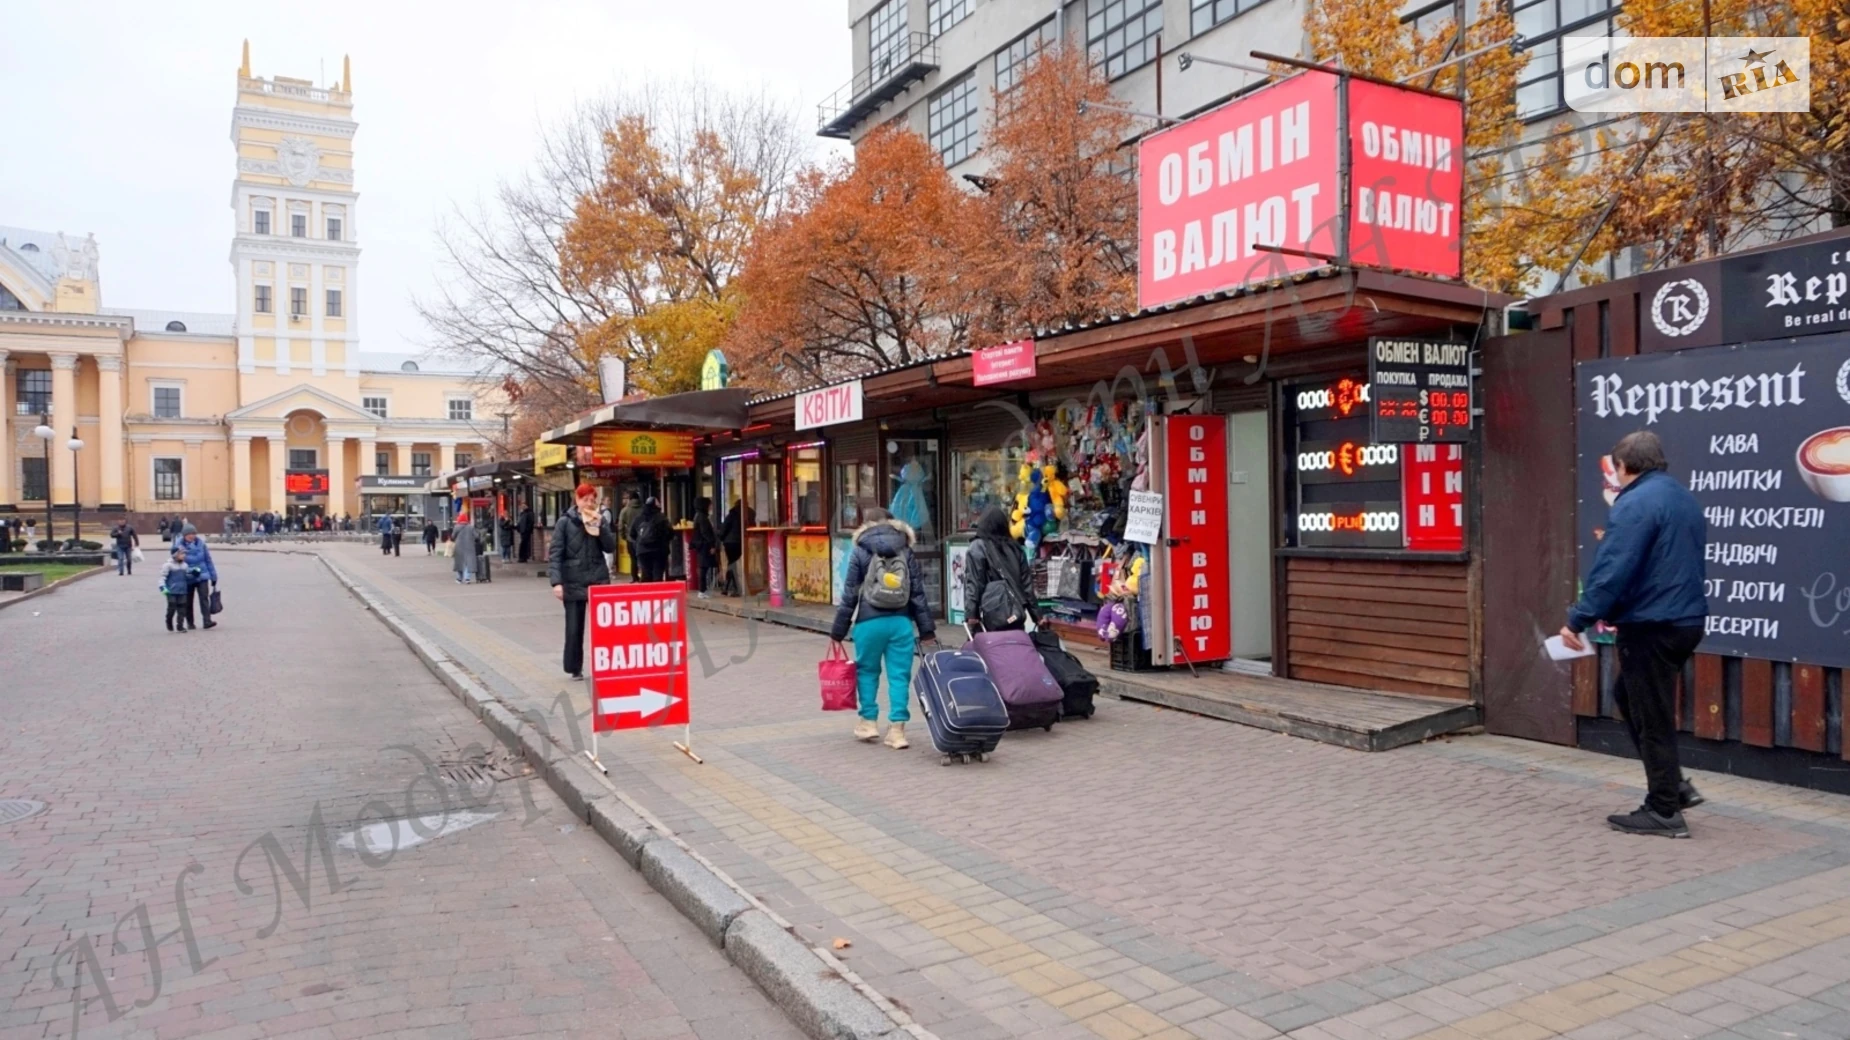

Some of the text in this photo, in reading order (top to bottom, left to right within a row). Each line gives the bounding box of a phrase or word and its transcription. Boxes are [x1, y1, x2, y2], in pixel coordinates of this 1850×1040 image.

[1158, 101, 1310, 206] ОБМІН
[1361, 121, 1451, 172] ОБМІН
[1358, 186, 1453, 238] ВАЛЮТ
[1153, 183, 1320, 282] ВАЛЮТ
[1765, 271, 1847, 308] Rep
[1784, 315, 1802, 328] Be
[1806, 309, 1834, 325] real
[1376, 341, 1468, 366] ОБМЕН ВАЛЮТ
[1377, 371, 1468, 388] ПОКУПКА ПРОДАЖА
[1590, 362, 1806, 425] Represent
[803, 385, 852, 427] КВІТИ
[1710, 433, 1759, 455] КАВА
[1188, 425, 1207, 525] ОБМІН
[1415, 444, 1436, 527] МІН
[1689, 469, 1782, 492] НАПИТКИ
[1130, 505, 1162, 515] ХАРКІВ
[1337, 516, 1360, 530] PLN
[1704, 506, 1825, 529] ЧНІ КОКТЕЛІ
[1704, 542, 1777, 566] ЕНДВІЧІ
[1190, 552, 1213, 652] ВАЛЮТ
[1704, 579, 1785, 603] ОТ ДОГИ
[1800, 572, 1850, 628] Co
[596, 598, 678, 628] ОБМІН
[594, 641, 684, 672] ВАЛЮТ
